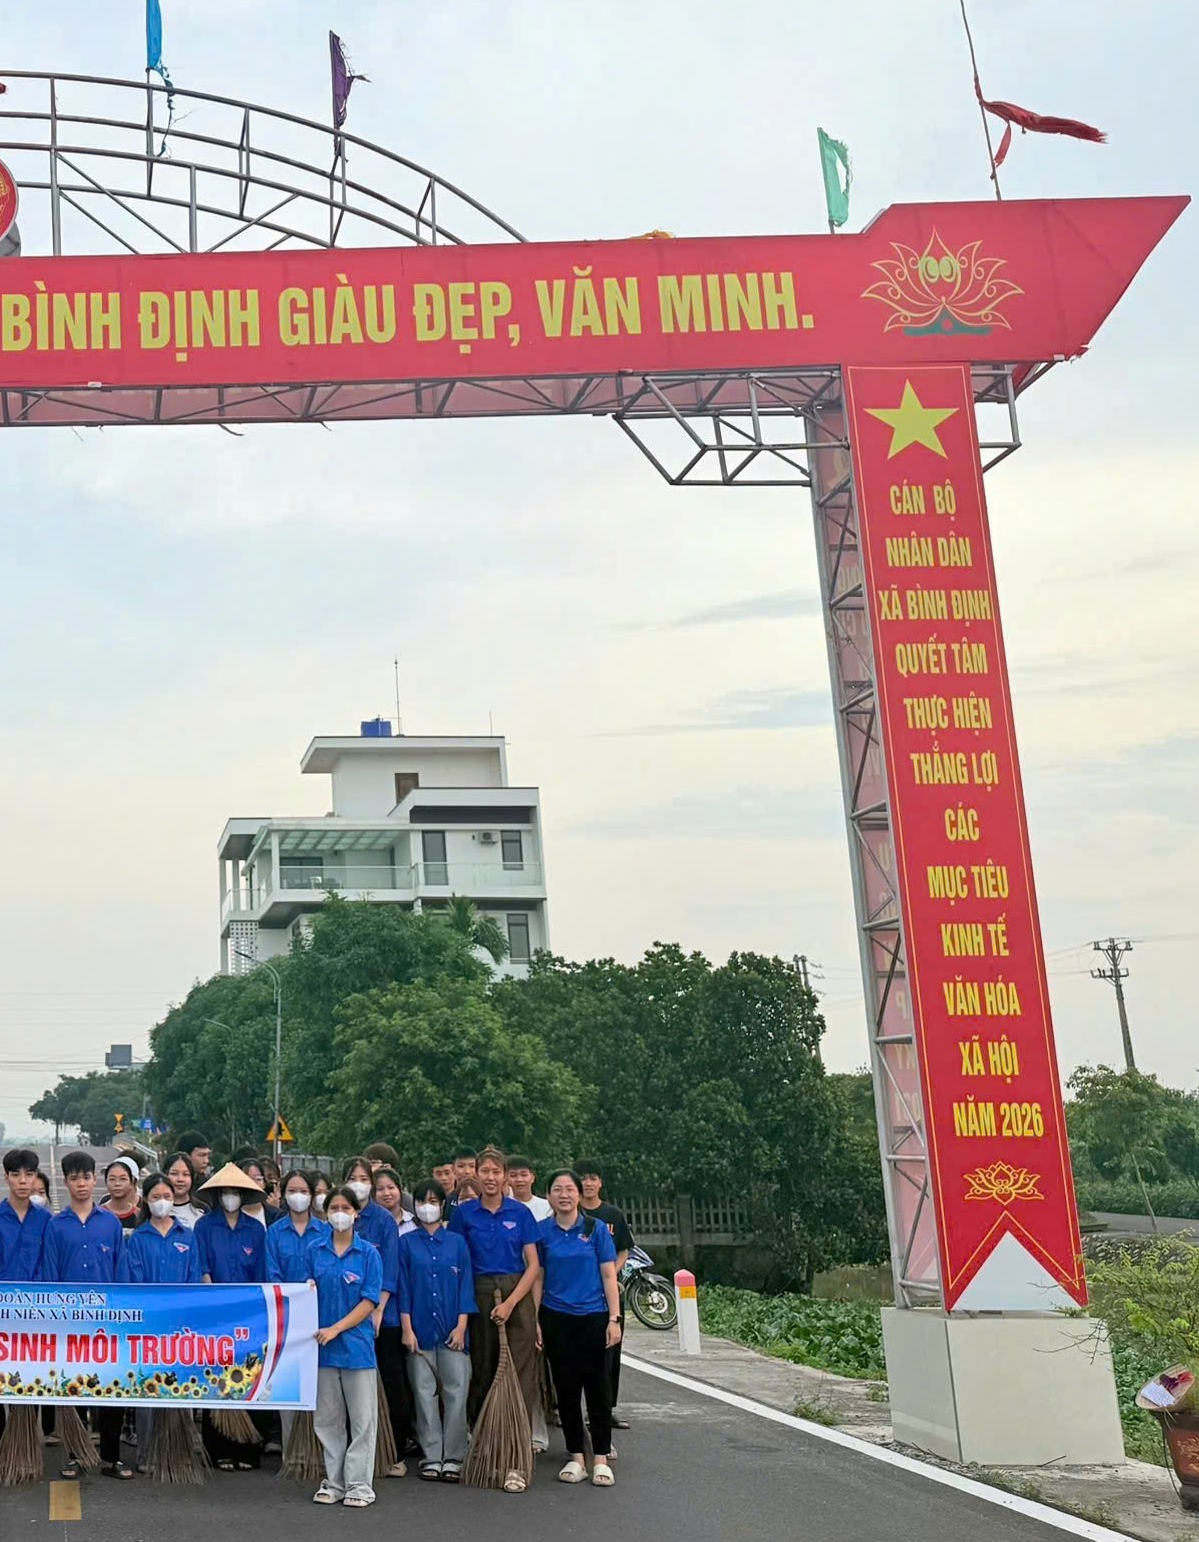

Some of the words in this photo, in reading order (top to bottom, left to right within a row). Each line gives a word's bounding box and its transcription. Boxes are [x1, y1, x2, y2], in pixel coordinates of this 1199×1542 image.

[2, 281, 121, 352] BÌNH
[138, 289, 260, 362] ĐỊNH
[279, 272, 396, 345] GIÀU
[413, 281, 521, 354] ĐẸP,
[536, 267, 642, 337] VĂN
[658, 272, 815, 333] MINH.
[890, 479, 925, 515] CÁN
[934, 480, 957, 522] BỘ
[886, 531, 934, 567] NHÂN
[938, 531, 972, 567] DÂN
[878, 584, 903, 621] XÃ
[907, 584, 947, 620] BÌNH
[951, 590, 992, 627] ĐỊNH
[895, 634, 947, 678] QUYẾT
[951, 637, 988, 674] TÂM
[904, 694, 949, 737] THỰC
[953, 691, 992, 735] HIỆN
[911, 741, 968, 785] THẮNG
[972, 752, 999, 791] LỢI
[944, 802, 980, 841] CÁC
[927, 864, 968, 906] MỤC
[971, 858, 1009, 898] TIÊU
[940, 923, 985, 957] KINH
[988, 913, 1010, 957] TẾ
[943, 974, 982, 1016] VĂN
[984, 975, 1021, 1016] HÓA
[959, 1035, 985, 1076] XÃ
[988, 1034, 1018, 1083] HỘI
[953, 1094, 996, 1137] NĂM
[1000, 1101, 1044, 1137] 2026
[14, 1306, 47, 1320] NIÊN
[49, 1306, 69, 1320] XÃ
[72, 1306, 104, 1321] BÌNH
[106, 1309, 142, 1324] ĐỊNH
[79, 1289, 106, 1305] YÊN
[66, 1326, 120, 1363] MÔI
